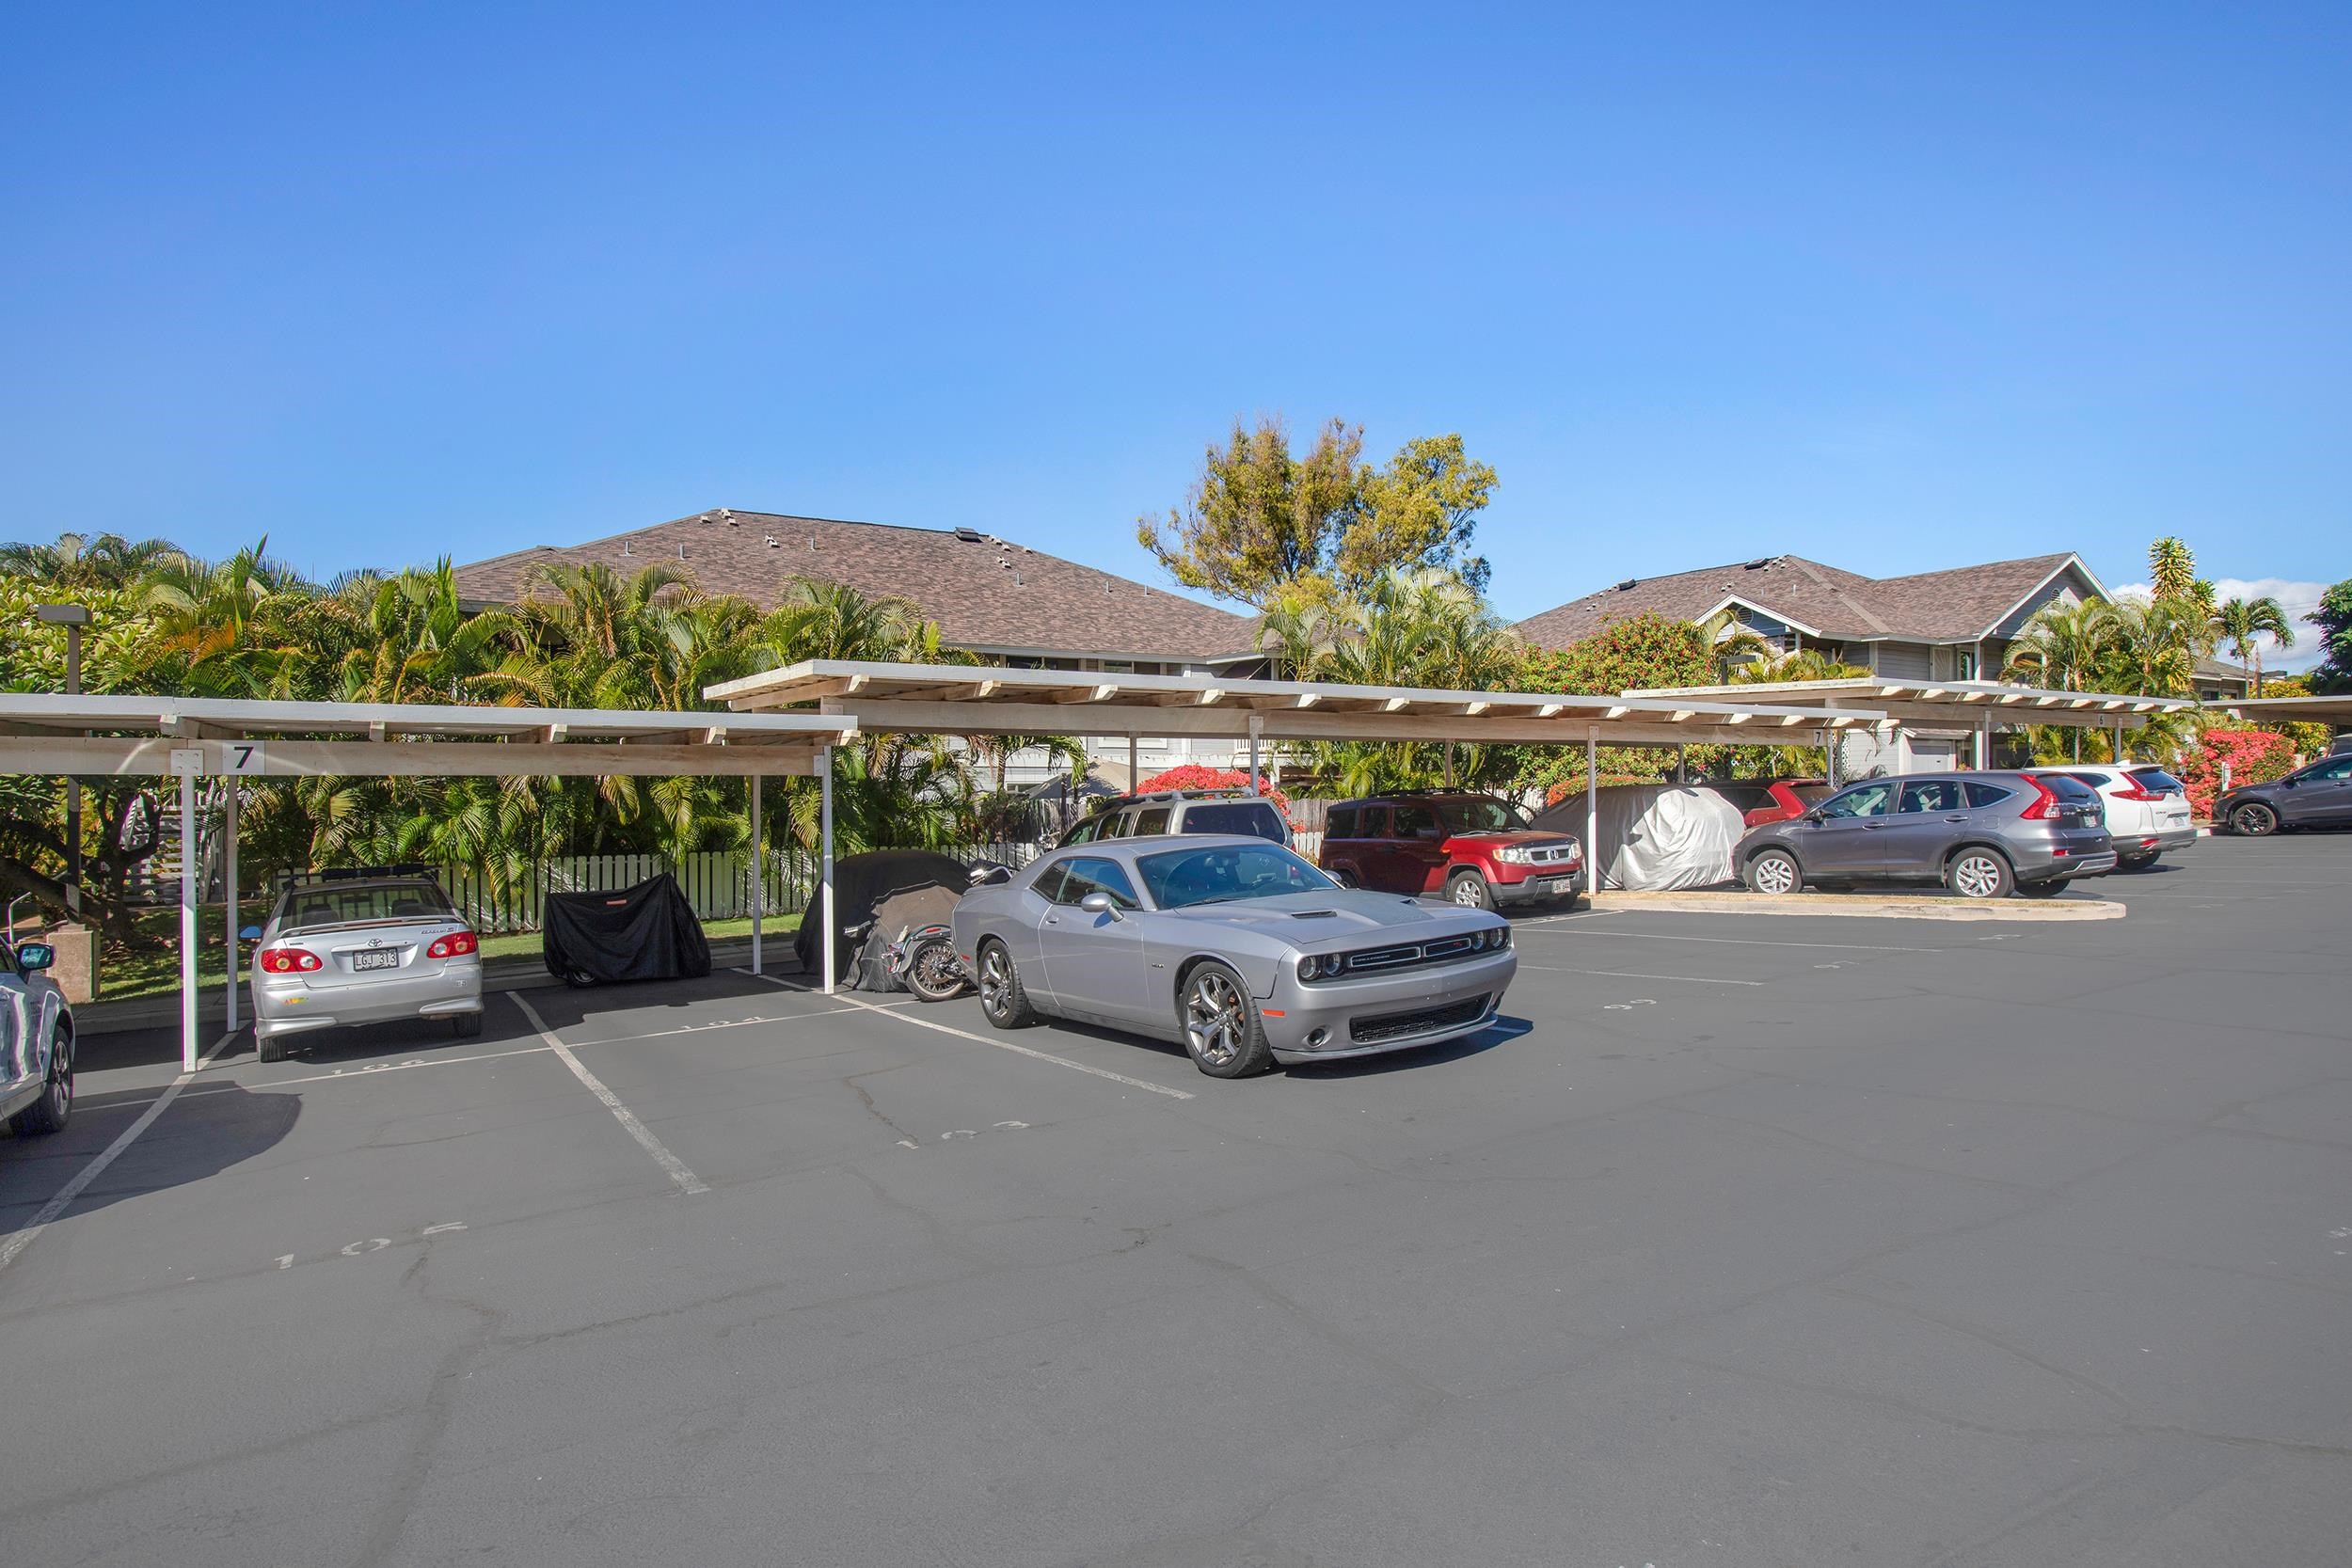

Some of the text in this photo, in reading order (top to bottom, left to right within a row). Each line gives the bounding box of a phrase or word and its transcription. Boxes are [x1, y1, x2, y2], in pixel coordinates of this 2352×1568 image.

[1815, 731, 1821, 743] 7
[233, 746, 255, 769] 7
[378, 952, 396, 964] 313
